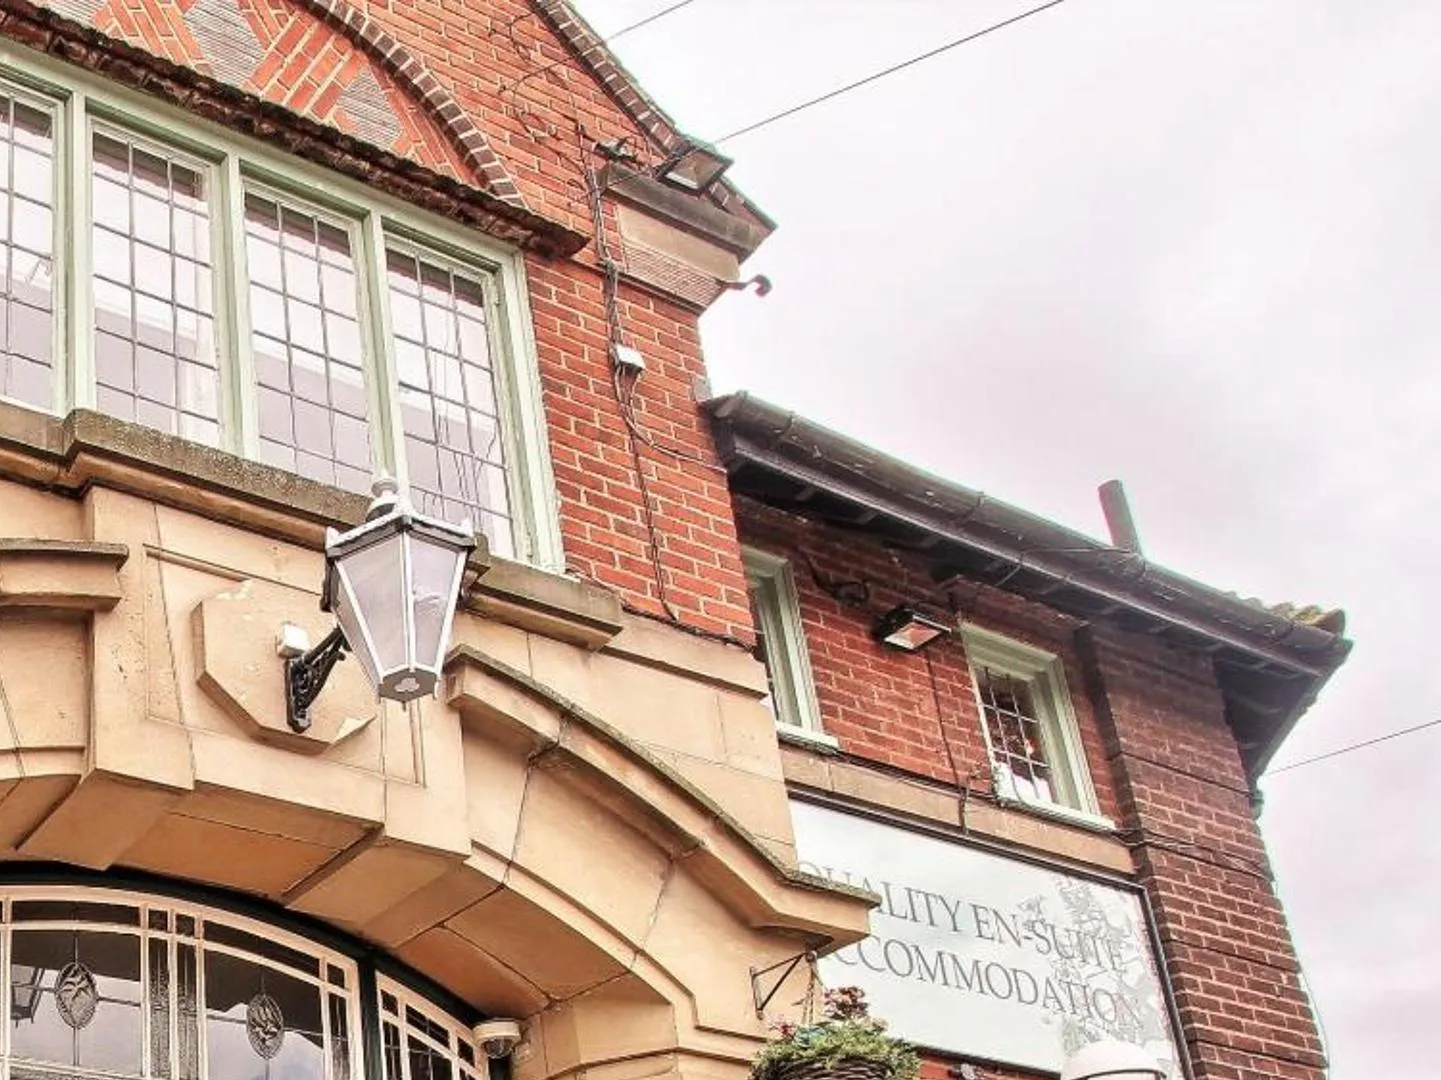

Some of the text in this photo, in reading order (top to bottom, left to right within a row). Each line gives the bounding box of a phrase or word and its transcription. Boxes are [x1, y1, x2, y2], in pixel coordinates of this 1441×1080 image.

[798, 860, 1127, 973] LITY EN-SUITE
[833, 934, 1144, 1029] COMMODATION
